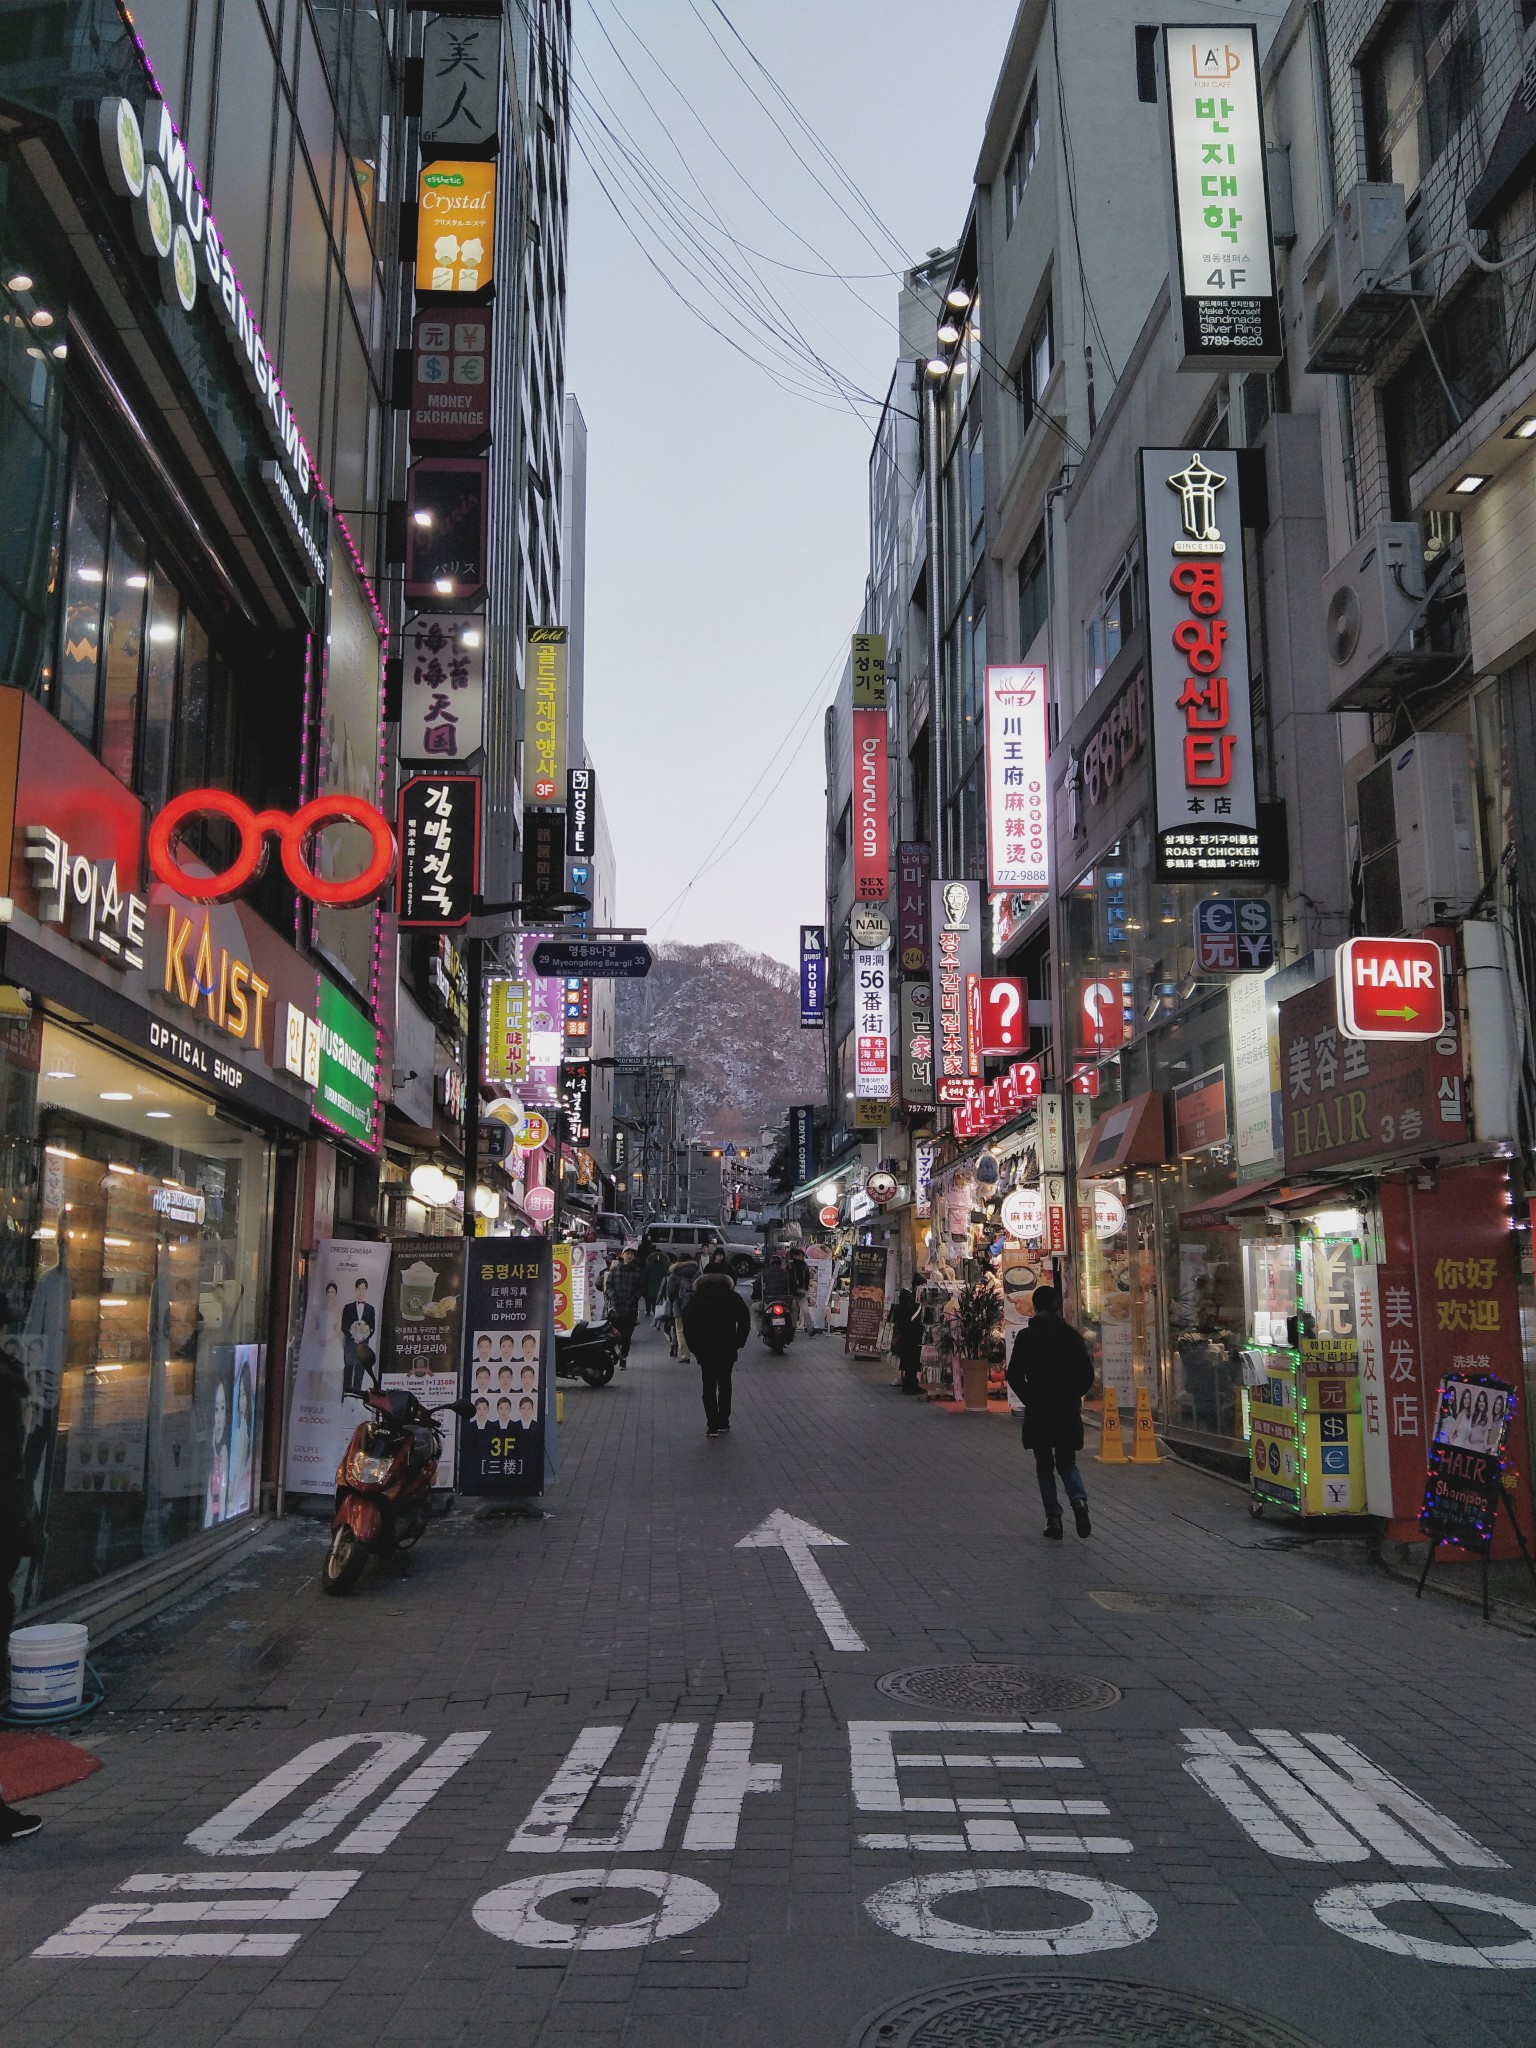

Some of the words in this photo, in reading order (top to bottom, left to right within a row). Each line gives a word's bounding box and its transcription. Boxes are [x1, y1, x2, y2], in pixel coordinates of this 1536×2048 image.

[436, 31, 486, 130] 美人
[424, 131, 438, 142] 6F
[1194, 98, 1243, 243] 반지대학
[427, 176, 462, 184] esthetic
[422, 191, 491, 214] Crystal
[434, 218, 463, 226] クリスタル
[465, 219, 487, 227] エステ
[1202, 253, 1251, 263] 명동캠퍼스
[1206, 268, 1247, 290] 4F
[1199, 315, 1262, 324] Handmade
[1225, 307, 1261, 315] Yourself
[426, 328, 443, 347] 元
[1200, 323, 1232, 334] Silver
[1234, 323, 1262, 336] Ring
[1201, 335, 1263, 346] 3789-6620
[428, 395, 473, 408] MONEY
[416, 411, 484, 425] EXCHANGE
[274, 460, 299, 526] DURIAN
[303, 526, 325, 584] COFFEE
[433, 563, 476, 574] パリス
[529, 629, 563, 643] Gold
[855, 637, 870, 691] 조성기
[1167, 562, 1237, 790] 영양센타
[535, 645, 557, 778] 골드국제여행사
[423, 693, 459, 757] 天国
[536, 784, 554, 796] 3F
[863, 738, 881, 858] bururu.com
[1187, 797, 1231, 815] 本店
[574, 790, 587, 852] HOSTEL
[421, 785, 454, 916] 김밥천국
[1165, 847, 1204, 856] ROAST
[1207, 847, 1259, 856] CHICKEN
[860, 878, 884, 887] SEX
[997, 870, 1047, 882] 772-9888
[860, 888, 885, 896] TOY
[902, 867, 926, 945] 마사지
[856, 919, 888, 930] NAIL
[1201, 905, 1233, 932] €
[804, 930, 821, 950] K
[539, 955, 550, 964] 29
[568, 946, 616, 957] 명동8나길
[634, 956, 646, 965] 33
[803, 953, 821, 962] guest
[859, 954, 884, 966] 明洞
[904, 951, 923, 964] 24시
[1203, 937, 1235, 968] 元
[552, 959, 604, 969] Myeongdong
[605, 959, 632, 968] 8na-gil
[164, 904, 270, 1050] KAIST
[860, 970, 884, 989] 56
[1356, 958, 1435, 990] HAIR
[807, 963, 817, 1007] HOUSE
[861, 991, 884, 1034] 番街
[150, 1022, 209, 1074] OPTICAL
[213, 1058, 244, 1090] SHOP
[288, 1015, 320, 1080] 안경
[857, 1085, 889, 1095] 774-9292
[859, 1104, 887, 1114] 조성기
[798, 1119, 806, 1145] EDIYA
[1291, 1090, 1371, 1157] HAIR
[1380, 1107, 1424, 1144] 3층
[798, 1146, 806, 1180] COFFEE
[330, 1246, 350, 1255] DRESS
[351, 1247, 373, 1255] CINEMA
[480, 1263, 540, 1280] 증명사진
[1434, 1257, 1498, 1291] 你好
[491, 1286, 529, 1297] 証明写真
[495, 1298, 524, 1309] 证件照
[491, 1313, 500, 1321] ID
[501, 1312, 527, 1321] PHOTO
[1437, 1299, 1501, 1331] 欢迎
[395, 1344, 448, 1355] 무상킹코리아
[1359, 1287, 1380, 1436] 美发店
[1385, 1286, 1419, 1438] 美发店
[1452, 1354, 1491, 1369] 洗头发
[1321, 1386, 1343, 1404] 元
[300, 1405, 325, 1414] SINGLE
[489, 1437, 516, 1457] 3F
[1440, 1450, 1487, 1484] HAIR
